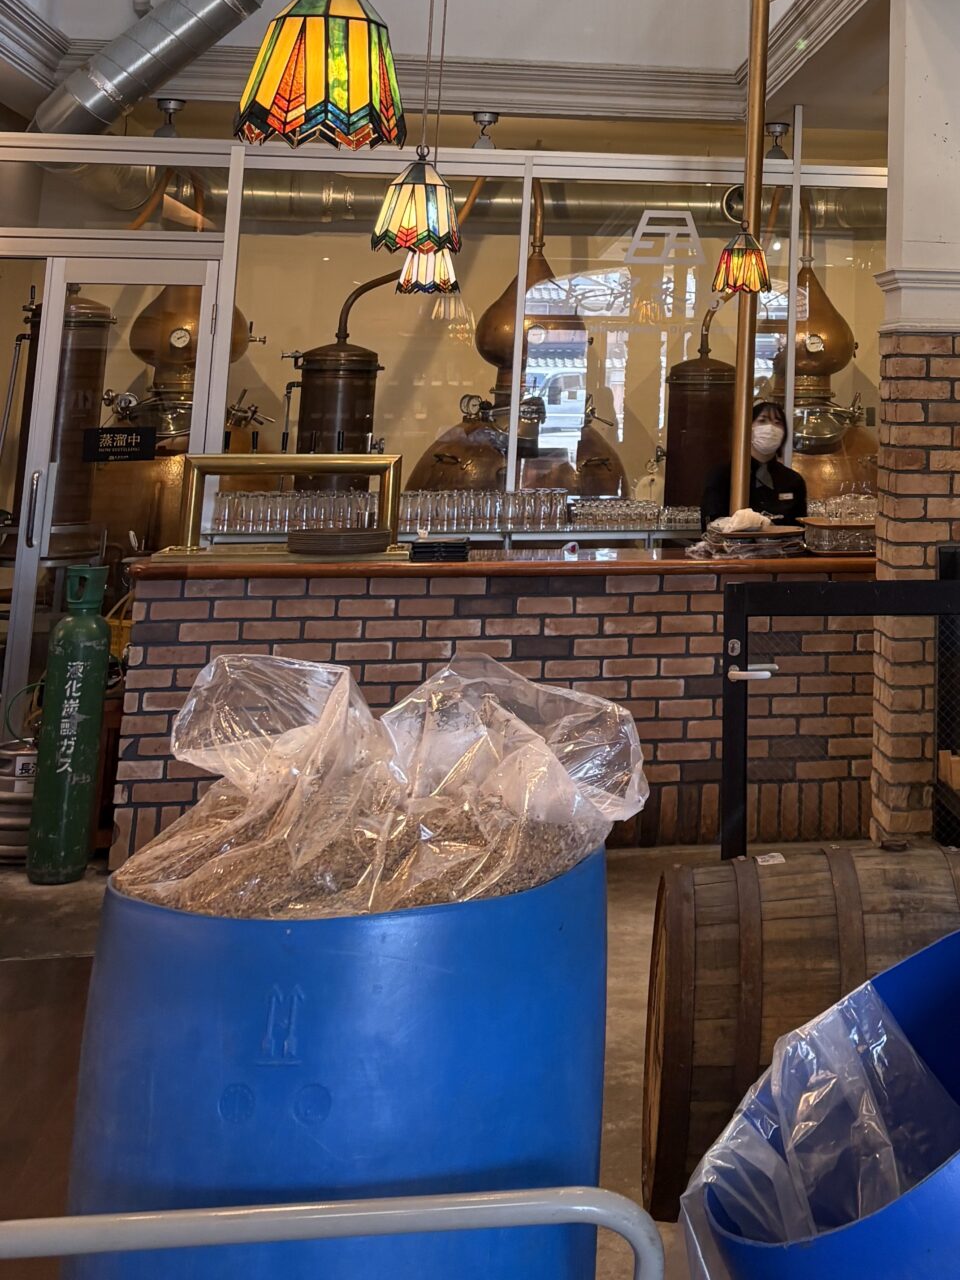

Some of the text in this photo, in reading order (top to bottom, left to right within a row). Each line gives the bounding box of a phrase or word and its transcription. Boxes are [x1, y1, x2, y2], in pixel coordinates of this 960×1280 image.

[99, 432, 140, 447] 蒸溜中
[56, 661, 85, 773] 液化炭酸ガス
